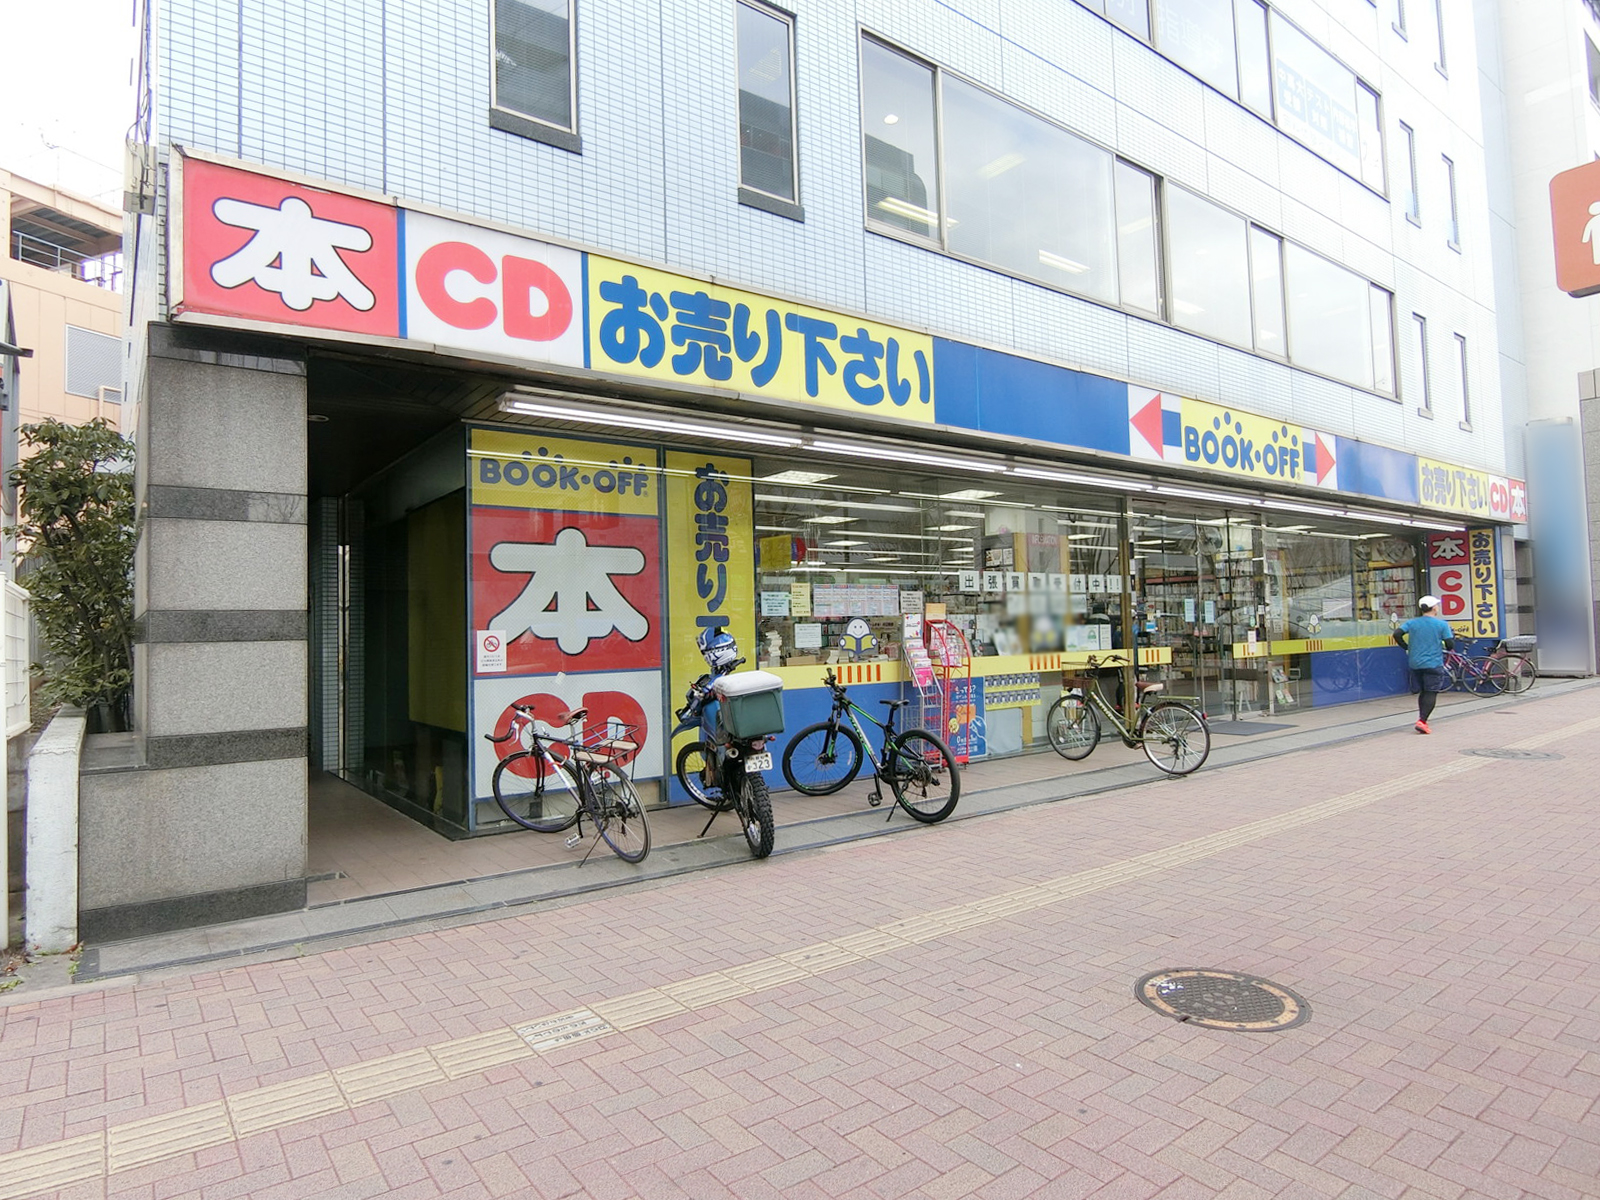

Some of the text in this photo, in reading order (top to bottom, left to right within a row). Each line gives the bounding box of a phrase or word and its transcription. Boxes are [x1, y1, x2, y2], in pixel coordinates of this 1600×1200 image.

[210, 196, 376, 311] 本
[415, 241, 573, 341] CD
[599, 275, 930, 406] お売り下さい
[1421, 463, 1488, 510] お売り下さい
[1490, 482, 1509, 513] CD
[1510, 485, 1526, 517] 本
[488, 526, 649, 656] 本
[1432, 537, 1466, 560] 本
[1472, 532, 1496, 635] お売り下さい
[1437, 570, 1466, 616] CD
[493, 691, 648, 779] CD
